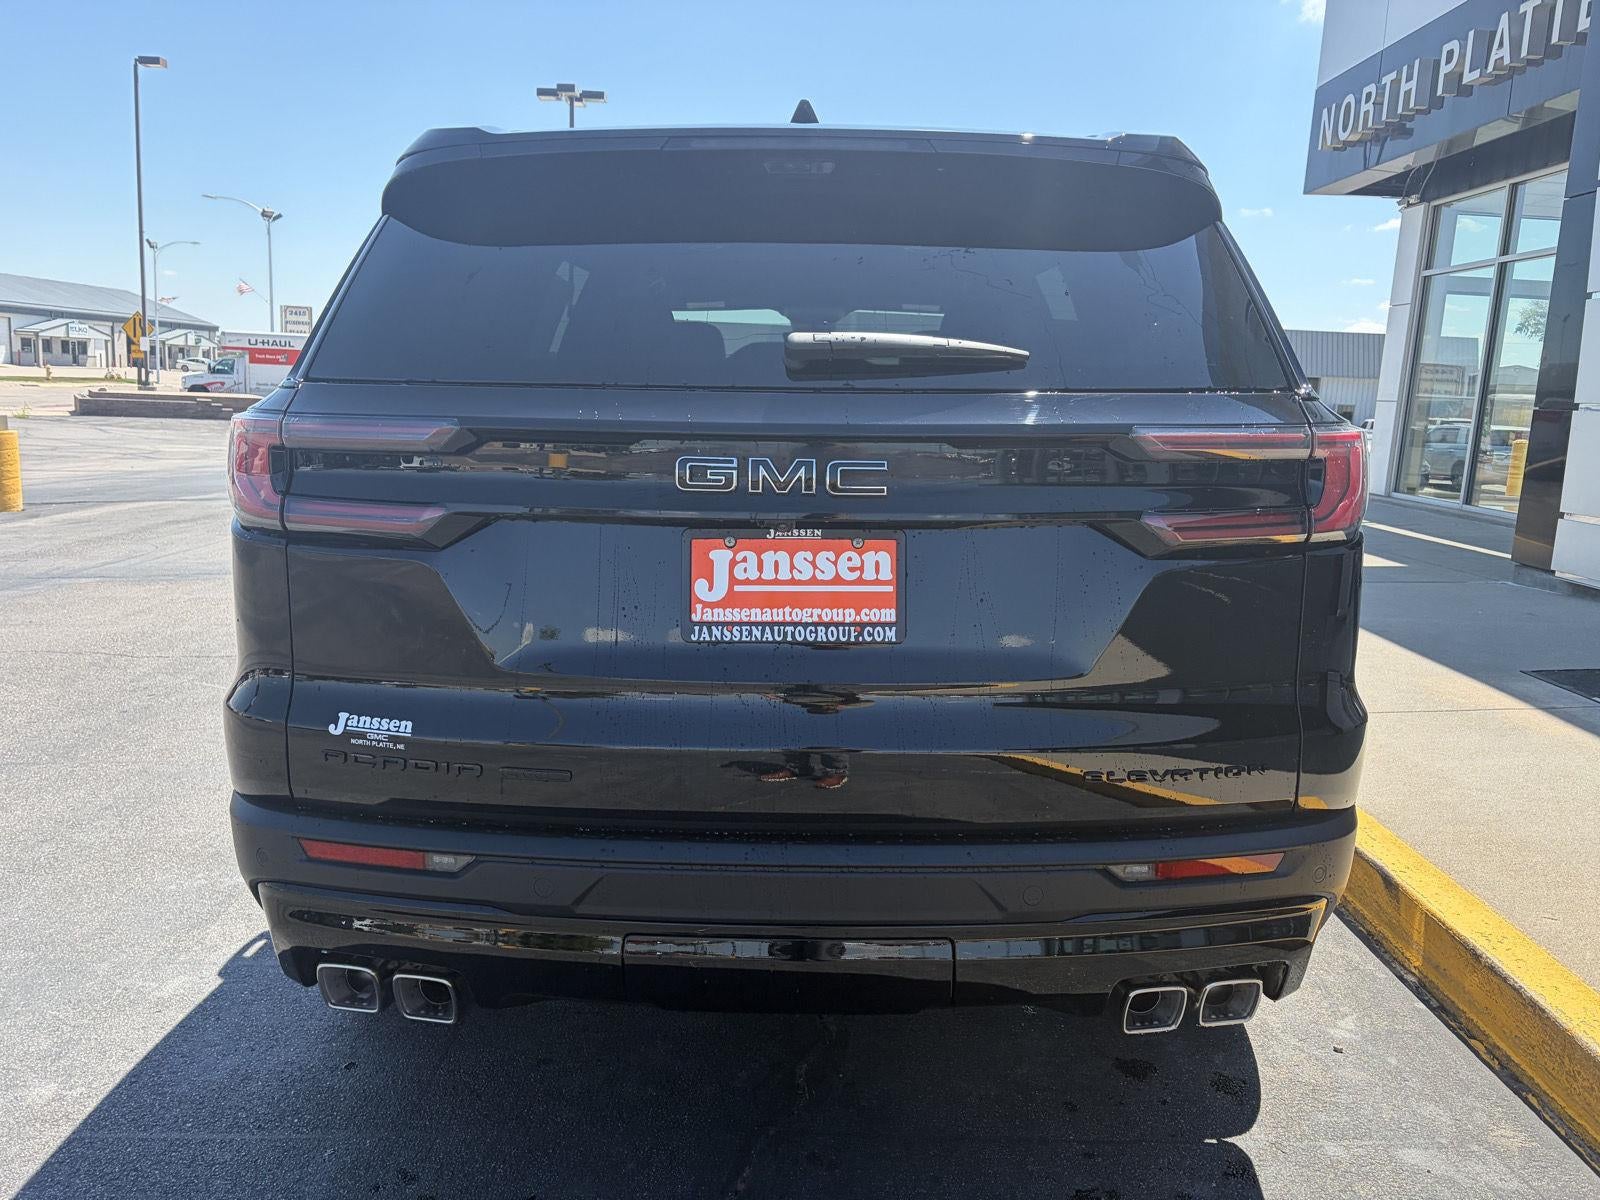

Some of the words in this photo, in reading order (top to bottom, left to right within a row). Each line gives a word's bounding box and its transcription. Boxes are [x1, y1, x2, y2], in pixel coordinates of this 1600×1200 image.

[1318, 57, 1420, 151] NORTH
[247, 338, 295, 348] U-HAUL
[675, 456, 888, 497] GMC
[766, 528, 822, 539] JANSSEN
[693, 548, 894, 603] Janssen
[691, 603, 897, 623] Janssenautogroup.com
[690, 625, 897, 642] JANSSENAUTOGROUP.COM
[328, 711, 413, 736] Janssen
[350, 738, 371, 746] NORTH
[372, 740, 396, 750] PLATTE,
[366, 733, 389, 741] GMC
[321, 748, 484, 779] ACADIA
[1083, 763, 1270, 783] ELEVATION
